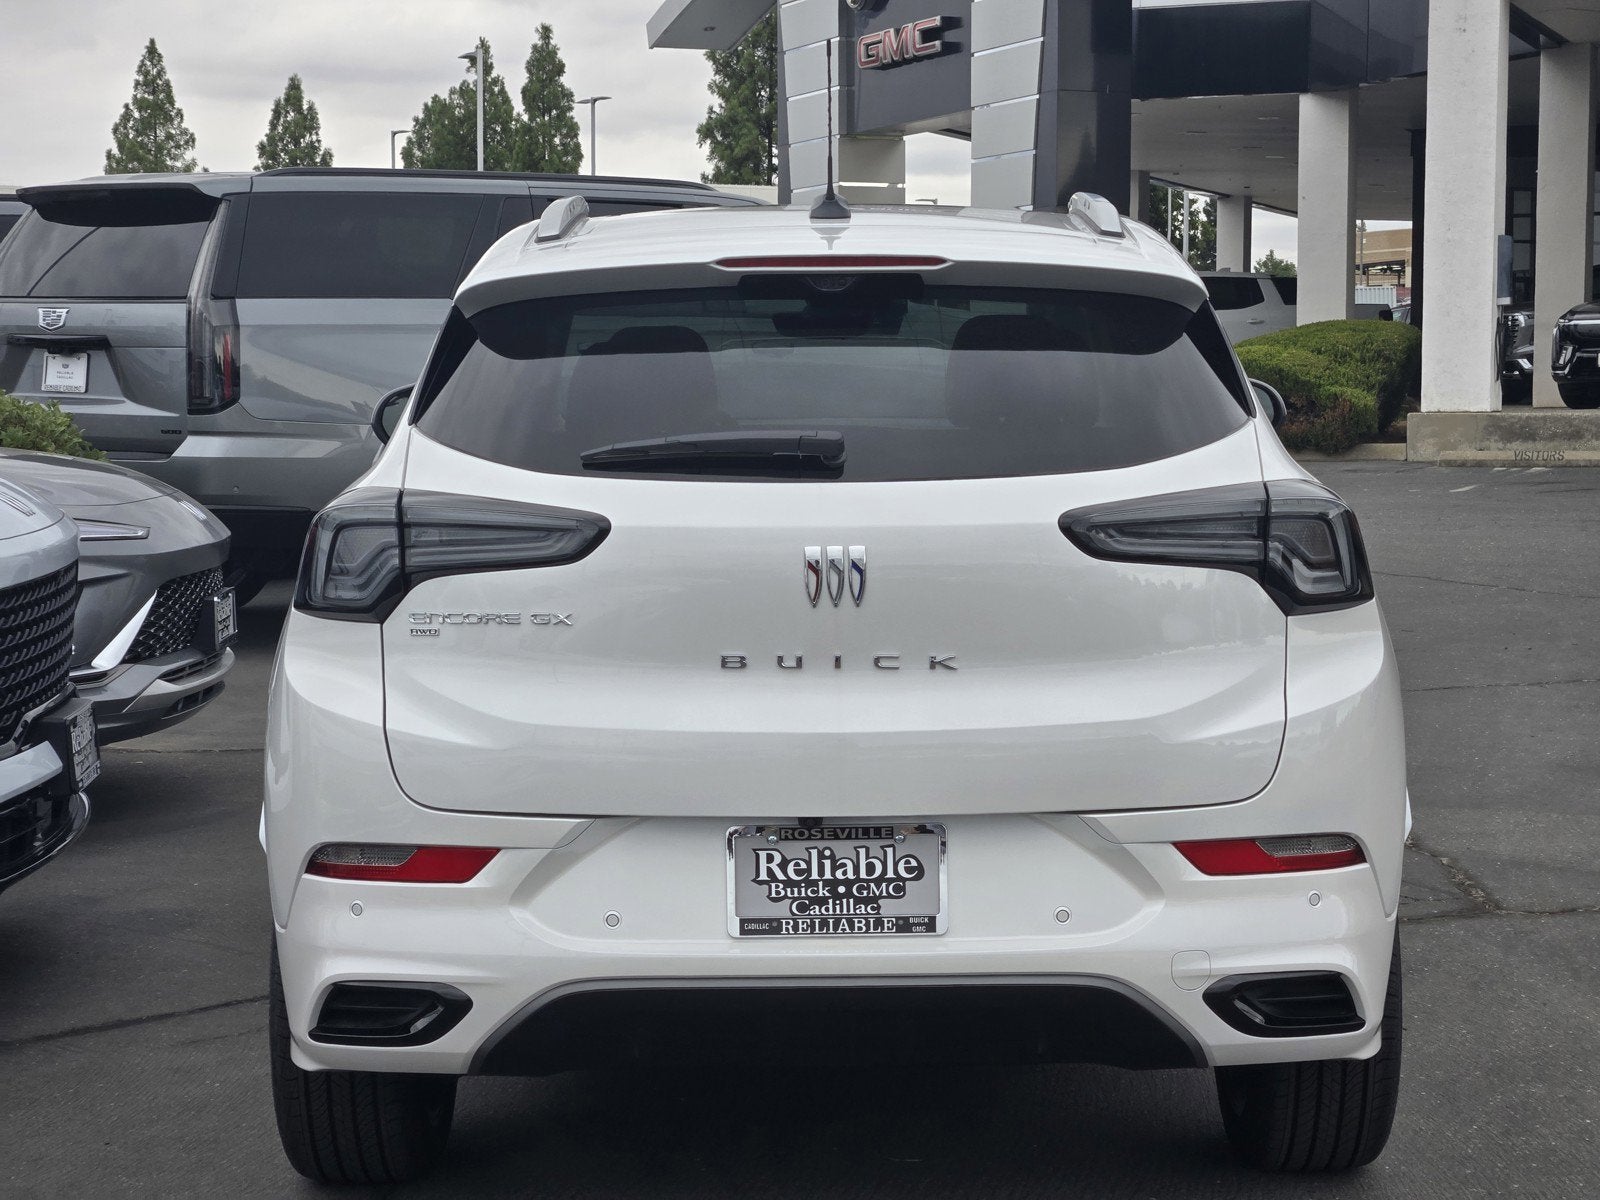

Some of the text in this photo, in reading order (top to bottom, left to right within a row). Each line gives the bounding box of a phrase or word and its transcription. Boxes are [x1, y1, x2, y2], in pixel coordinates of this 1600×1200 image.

[857, 15, 941, 69] GMC
[1514, 450, 1565, 461] VISITORS
[409, 612, 573, 626] ENCORE GX
[720, 654, 958, 670] BUICK
[780, 827, 893, 840] ROSEVILLE
[755, 845, 919, 882] Reliable
[769, 881, 905, 898] Buick GMC
[791, 899, 878, 915] Cadillac
[780, 917, 896, 934] RELIABLE
[909, 916, 929, 924] BUICK
